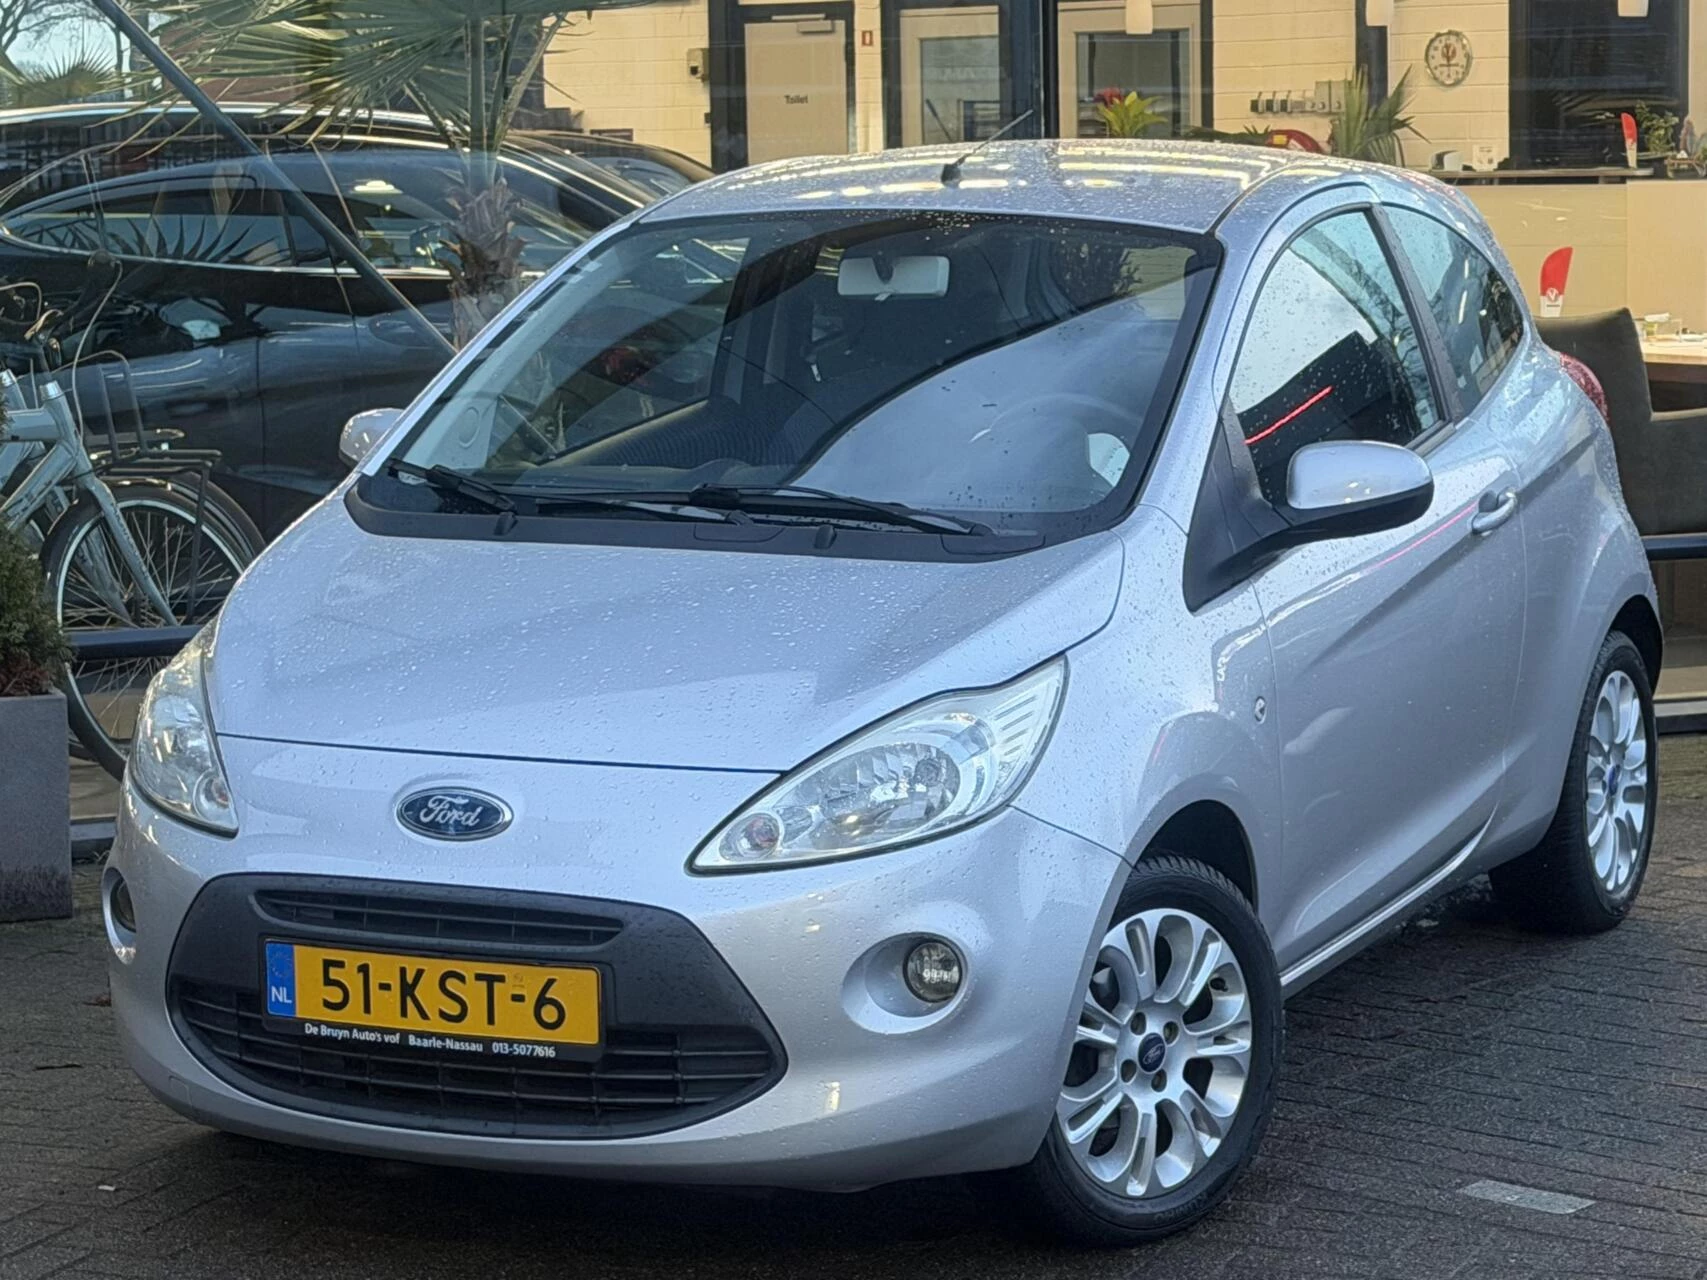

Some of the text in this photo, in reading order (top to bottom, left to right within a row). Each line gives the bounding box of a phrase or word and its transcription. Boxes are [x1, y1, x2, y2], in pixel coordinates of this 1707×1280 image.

[784, 95, 808, 104] Toilet
[419, 795, 483, 826] Ford
[271, 986, 292, 1004] NL
[322, 958, 566, 1031] 51-KST-6
[305, 1023, 557, 1058] De Bruyn Auto's vof Baarle-Nassau 013-5077616
